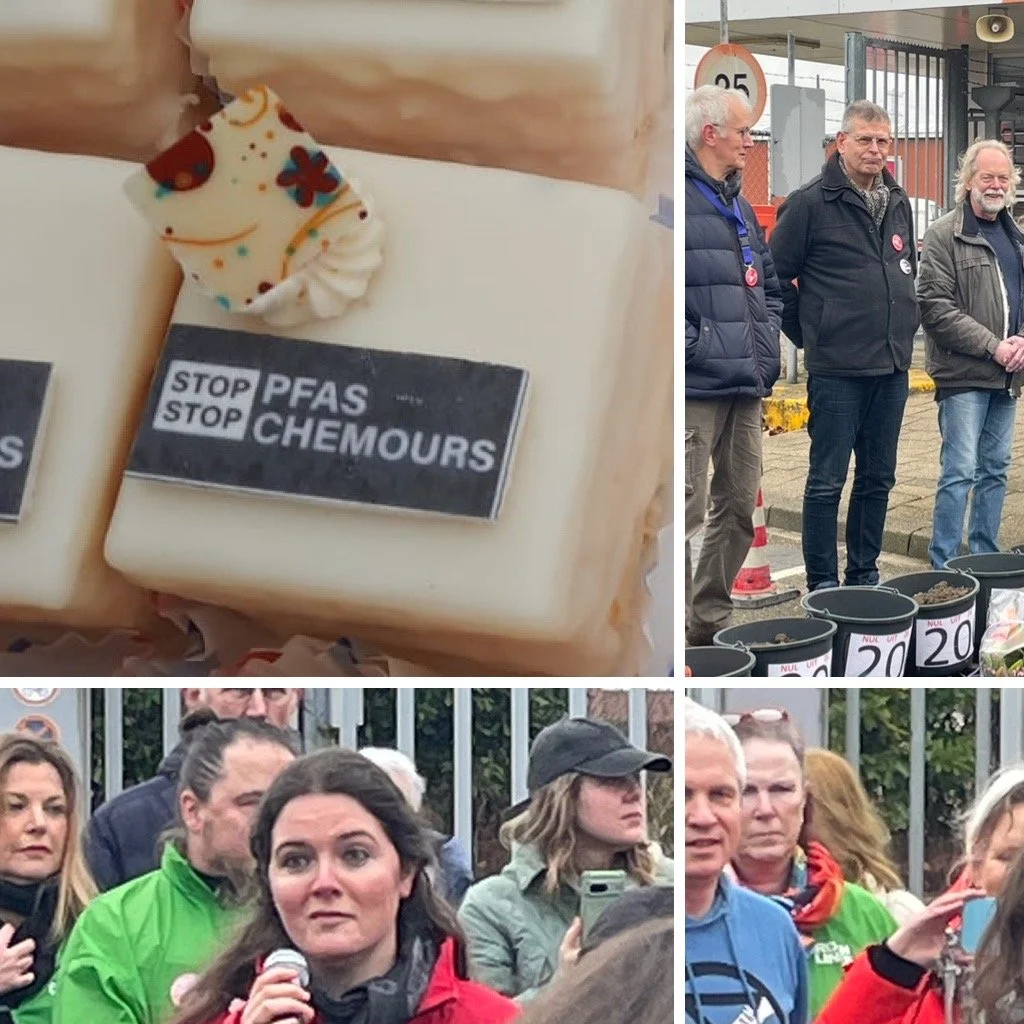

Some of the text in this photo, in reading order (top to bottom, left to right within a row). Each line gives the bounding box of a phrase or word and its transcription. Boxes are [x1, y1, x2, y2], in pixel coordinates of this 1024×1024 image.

[170, 371, 368, 416] STOP PFAS
[163, 401, 497, 472] STOP CHEMOURS
[858, 641, 906, 677] 20
[924, 619, 972, 666] 20
[780, 665, 798, 673] NUL
